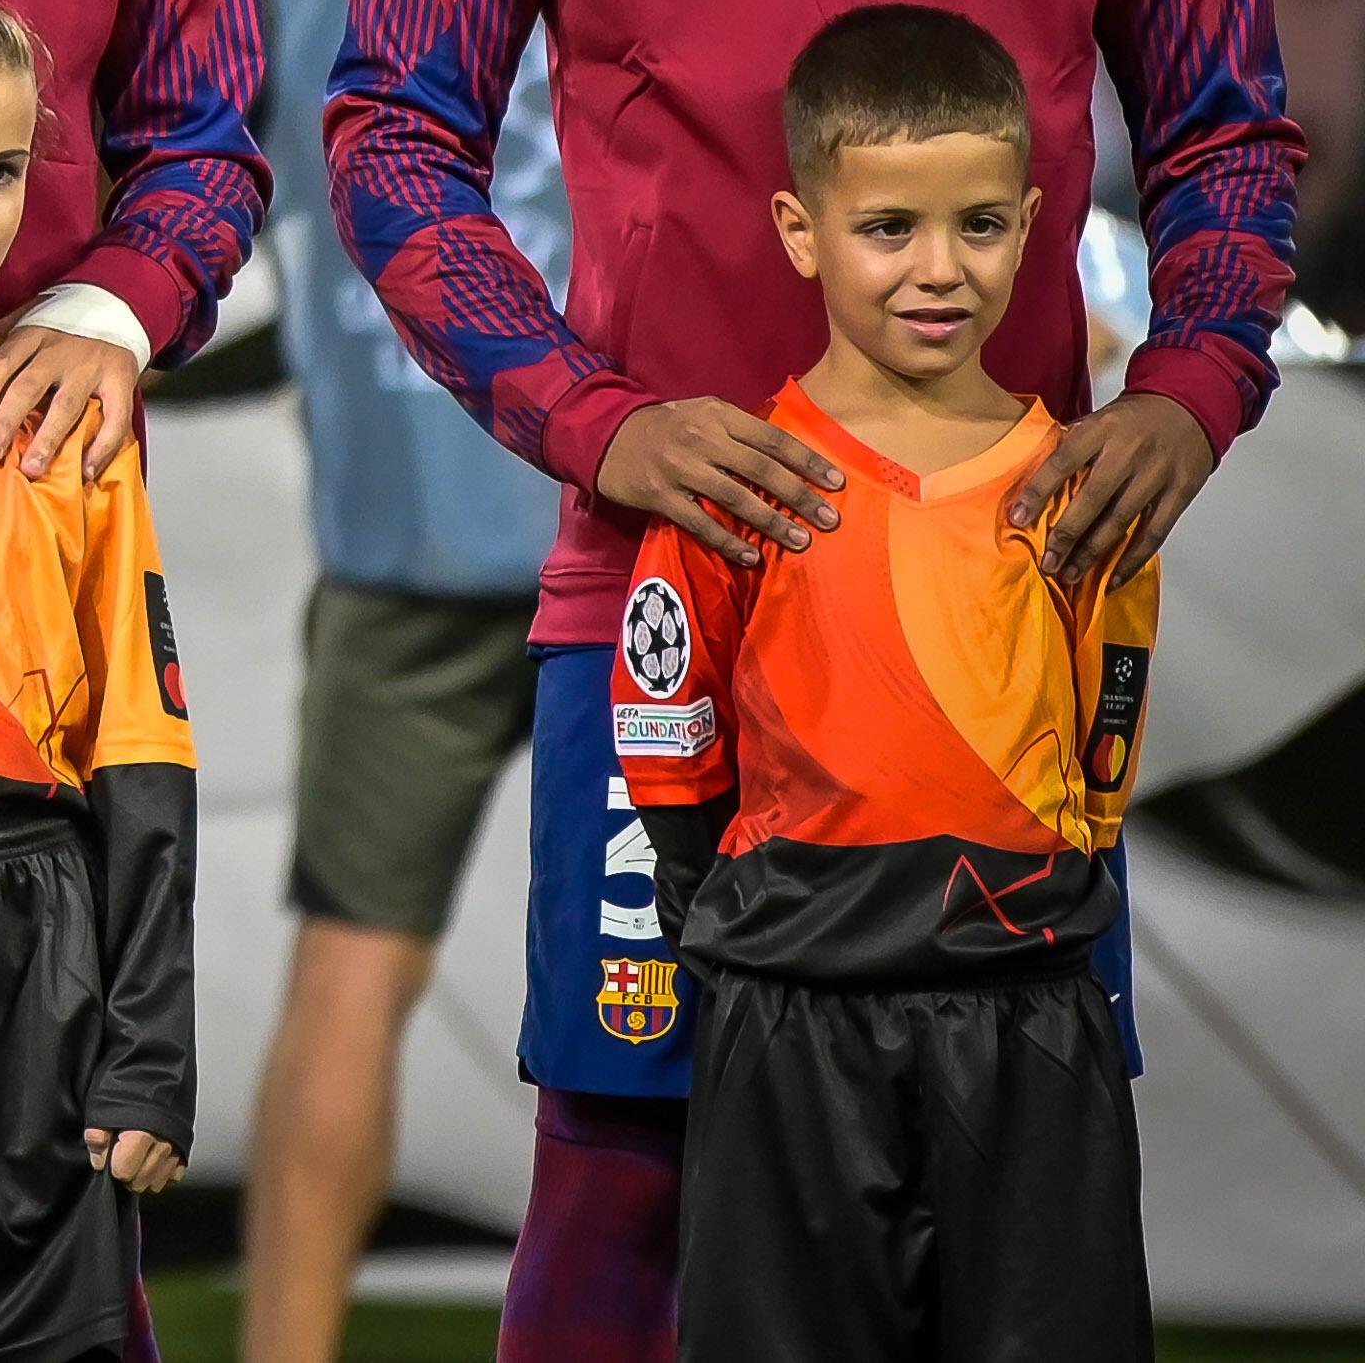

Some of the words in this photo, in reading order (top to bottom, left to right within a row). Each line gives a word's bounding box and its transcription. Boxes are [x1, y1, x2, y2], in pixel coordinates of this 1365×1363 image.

[617, 707, 639, 719] UEFA
[617, 713, 713, 739] FOUNDATION
[622, 993, 653, 1005] FCB
